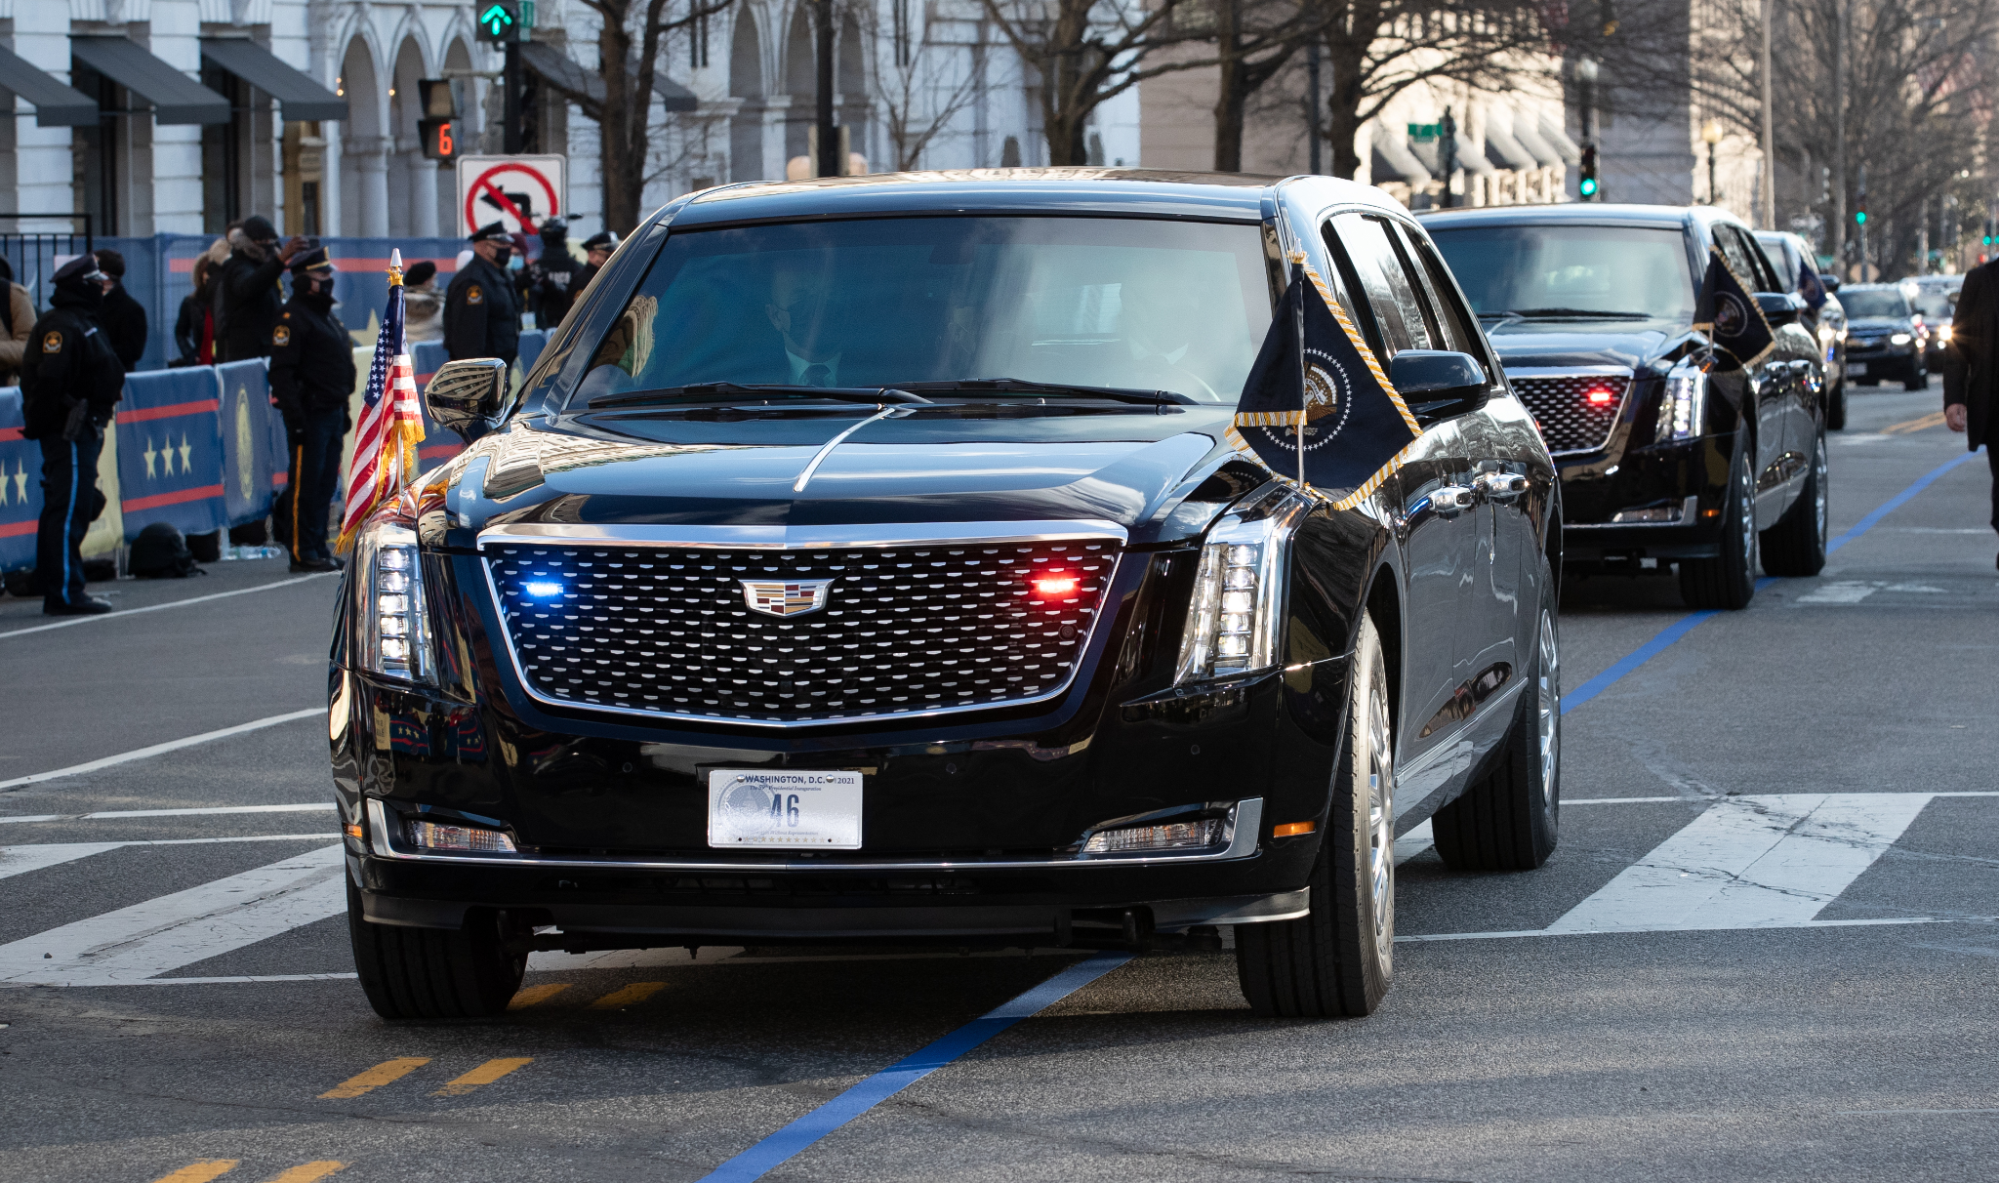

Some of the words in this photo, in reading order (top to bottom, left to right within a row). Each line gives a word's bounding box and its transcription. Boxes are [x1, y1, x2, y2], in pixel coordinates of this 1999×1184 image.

[439, 123, 453, 156] 6
[745, 775, 807, 785] WASHINGTON,
[808, 776, 826, 784] D.C.
[837, 777, 855, 785] 2021
[770, 793, 800, 828] 46
